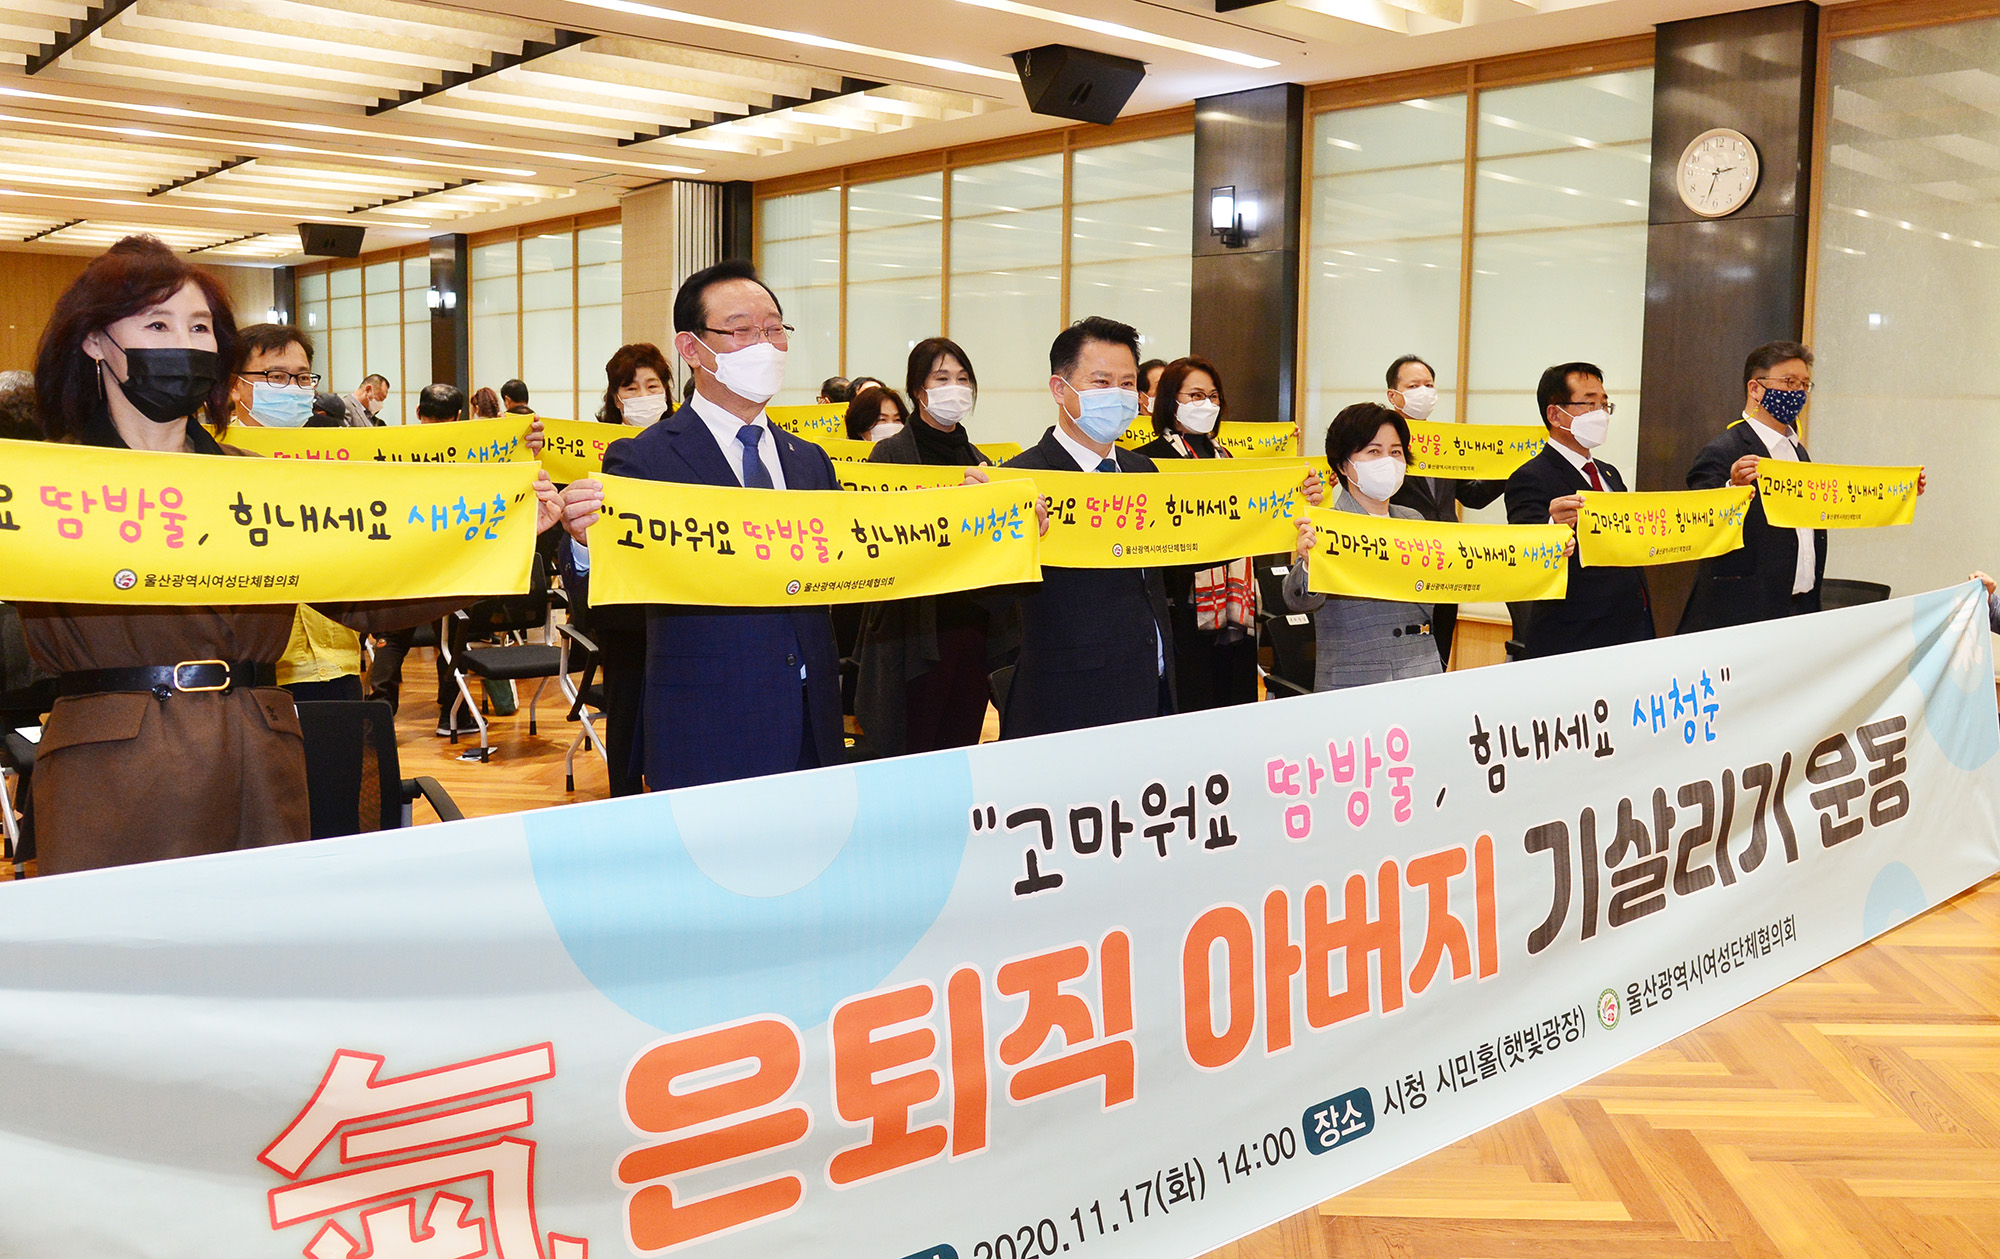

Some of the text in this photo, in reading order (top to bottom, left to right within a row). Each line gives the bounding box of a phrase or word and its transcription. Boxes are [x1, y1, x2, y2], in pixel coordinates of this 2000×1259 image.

[1453, 437, 1504, 456] 힘내세요
[1046, 495, 1076, 524] 워요
[1086, 493, 1156, 530] 땀방울,
[1165, 494, 1241, 526] 힘내세요
[1847, 480, 1884, 503] 힘내세요
[40, 484, 209, 549] 땀방울,
[229, 491, 392, 547] 힘내세요
[408, 493, 525, 541] 새청춘"
[600, 500, 1034, 563] "고마워요 땀방울, 힘내세요 새청춘"
[1584, 509, 1631, 534] "고마워요
[1634, 508, 1672, 536] 땀방울,
[1675, 507, 1714, 533] 힘내세요
[1125, 542, 1198, 555] 울산광역시여성단체협의회
[1315, 525, 1390, 561] "고마워요
[1394, 537, 1453, 570] 땀방울,
[1457, 540, 1517, 570] 힘내세요
[144, 573, 300, 588] 울산광역시여성단체협의회
[804, 576, 895, 592] 울산광역시여성단체협의회
[972, 666, 1732, 896] "고마워요 땀방울, 힘내세요 새청춘"
[1625, 913, 1798, 1017] 울산광역시여성단체협의회
[257, 714, 1910, 1259] 氣 은퇴직 아버지 기살리기 운동
[1217, 1126, 1297, 1185] 14:00
[1313, 1099, 1371, 1149] 장소
[1382, 1070, 1429, 1117] 시청
[1434, 1004, 1588, 1094] 시민홀(햇빛광장)
